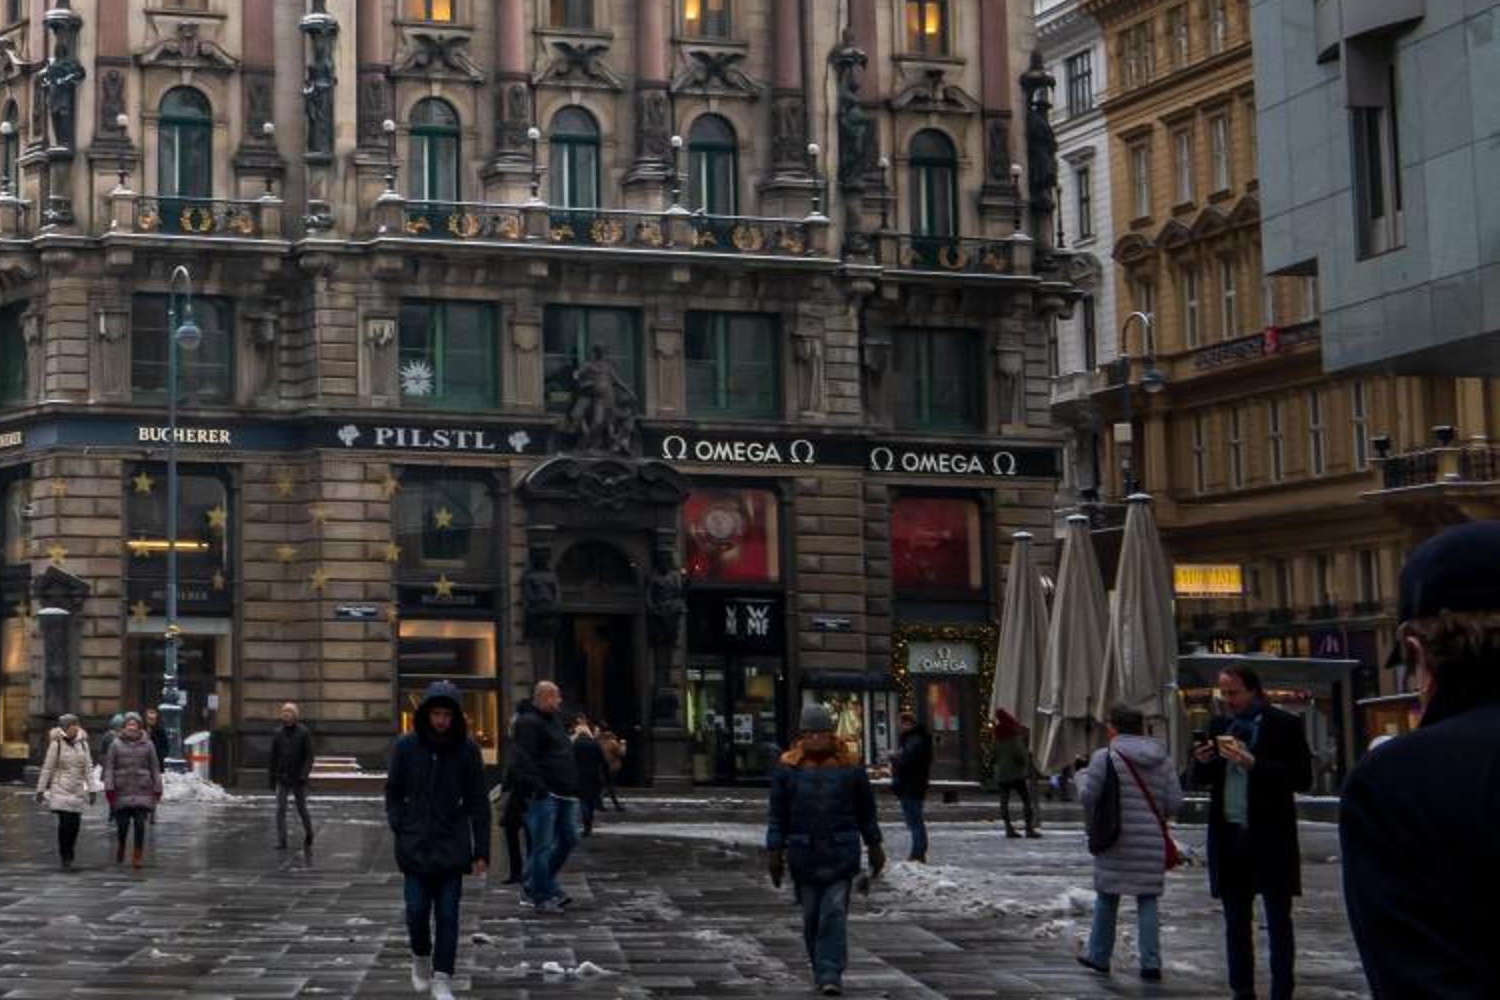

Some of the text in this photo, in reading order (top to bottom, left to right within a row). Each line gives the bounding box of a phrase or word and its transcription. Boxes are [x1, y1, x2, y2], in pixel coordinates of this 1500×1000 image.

[138, 427, 231, 444] BUCHERER
[374, 427, 496, 450] PILSTL
[694, 441, 782, 463] OMEGA
[901, 451, 986, 475] OMEGA
[923, 658, 968, 672] OMEGA
